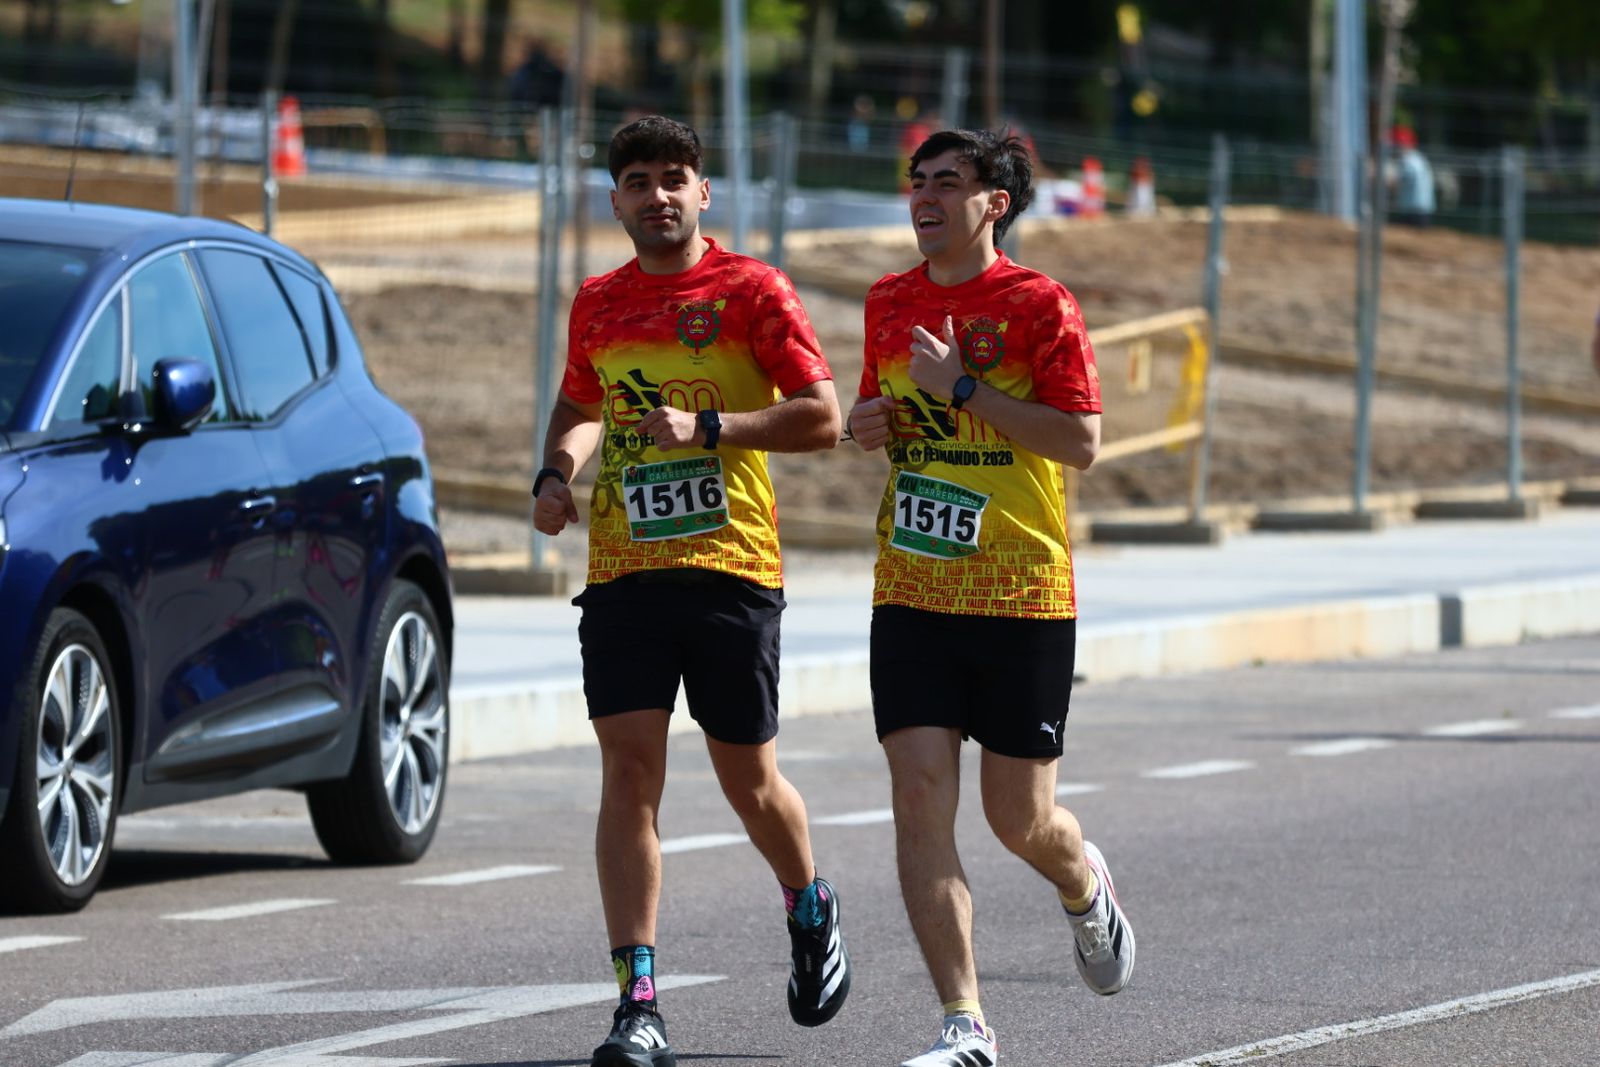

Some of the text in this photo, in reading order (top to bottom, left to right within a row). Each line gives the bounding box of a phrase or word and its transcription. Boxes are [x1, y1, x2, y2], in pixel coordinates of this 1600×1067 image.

[649, 468, 694, 481] CARRERA
[629, 477, 722, 518] 1516
[918, 486, 957, 502] CARRERA
[899, 495, 976, 543] 1515
[966, 599, 988, 608] VALOR
[991, 599, 1006, 610] POR
